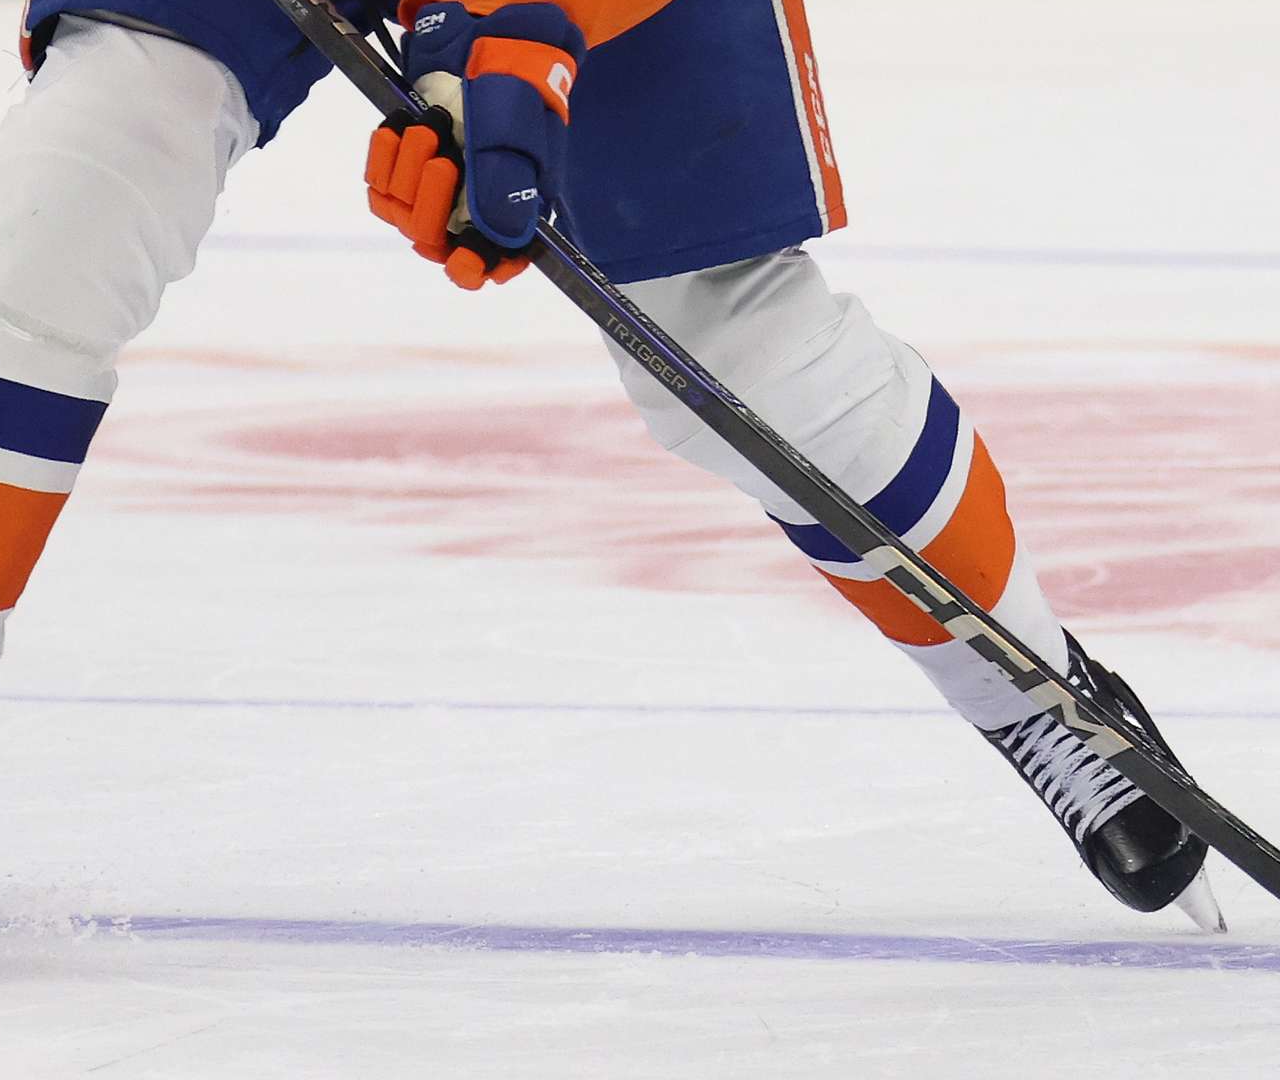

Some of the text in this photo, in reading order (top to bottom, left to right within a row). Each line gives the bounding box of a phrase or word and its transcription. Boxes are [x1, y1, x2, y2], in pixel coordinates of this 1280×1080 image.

[415, 11, 446, 31] CCM
[604, 312, 688, 392] TRIGGER
[860, 544, 1136, 760] CCM
